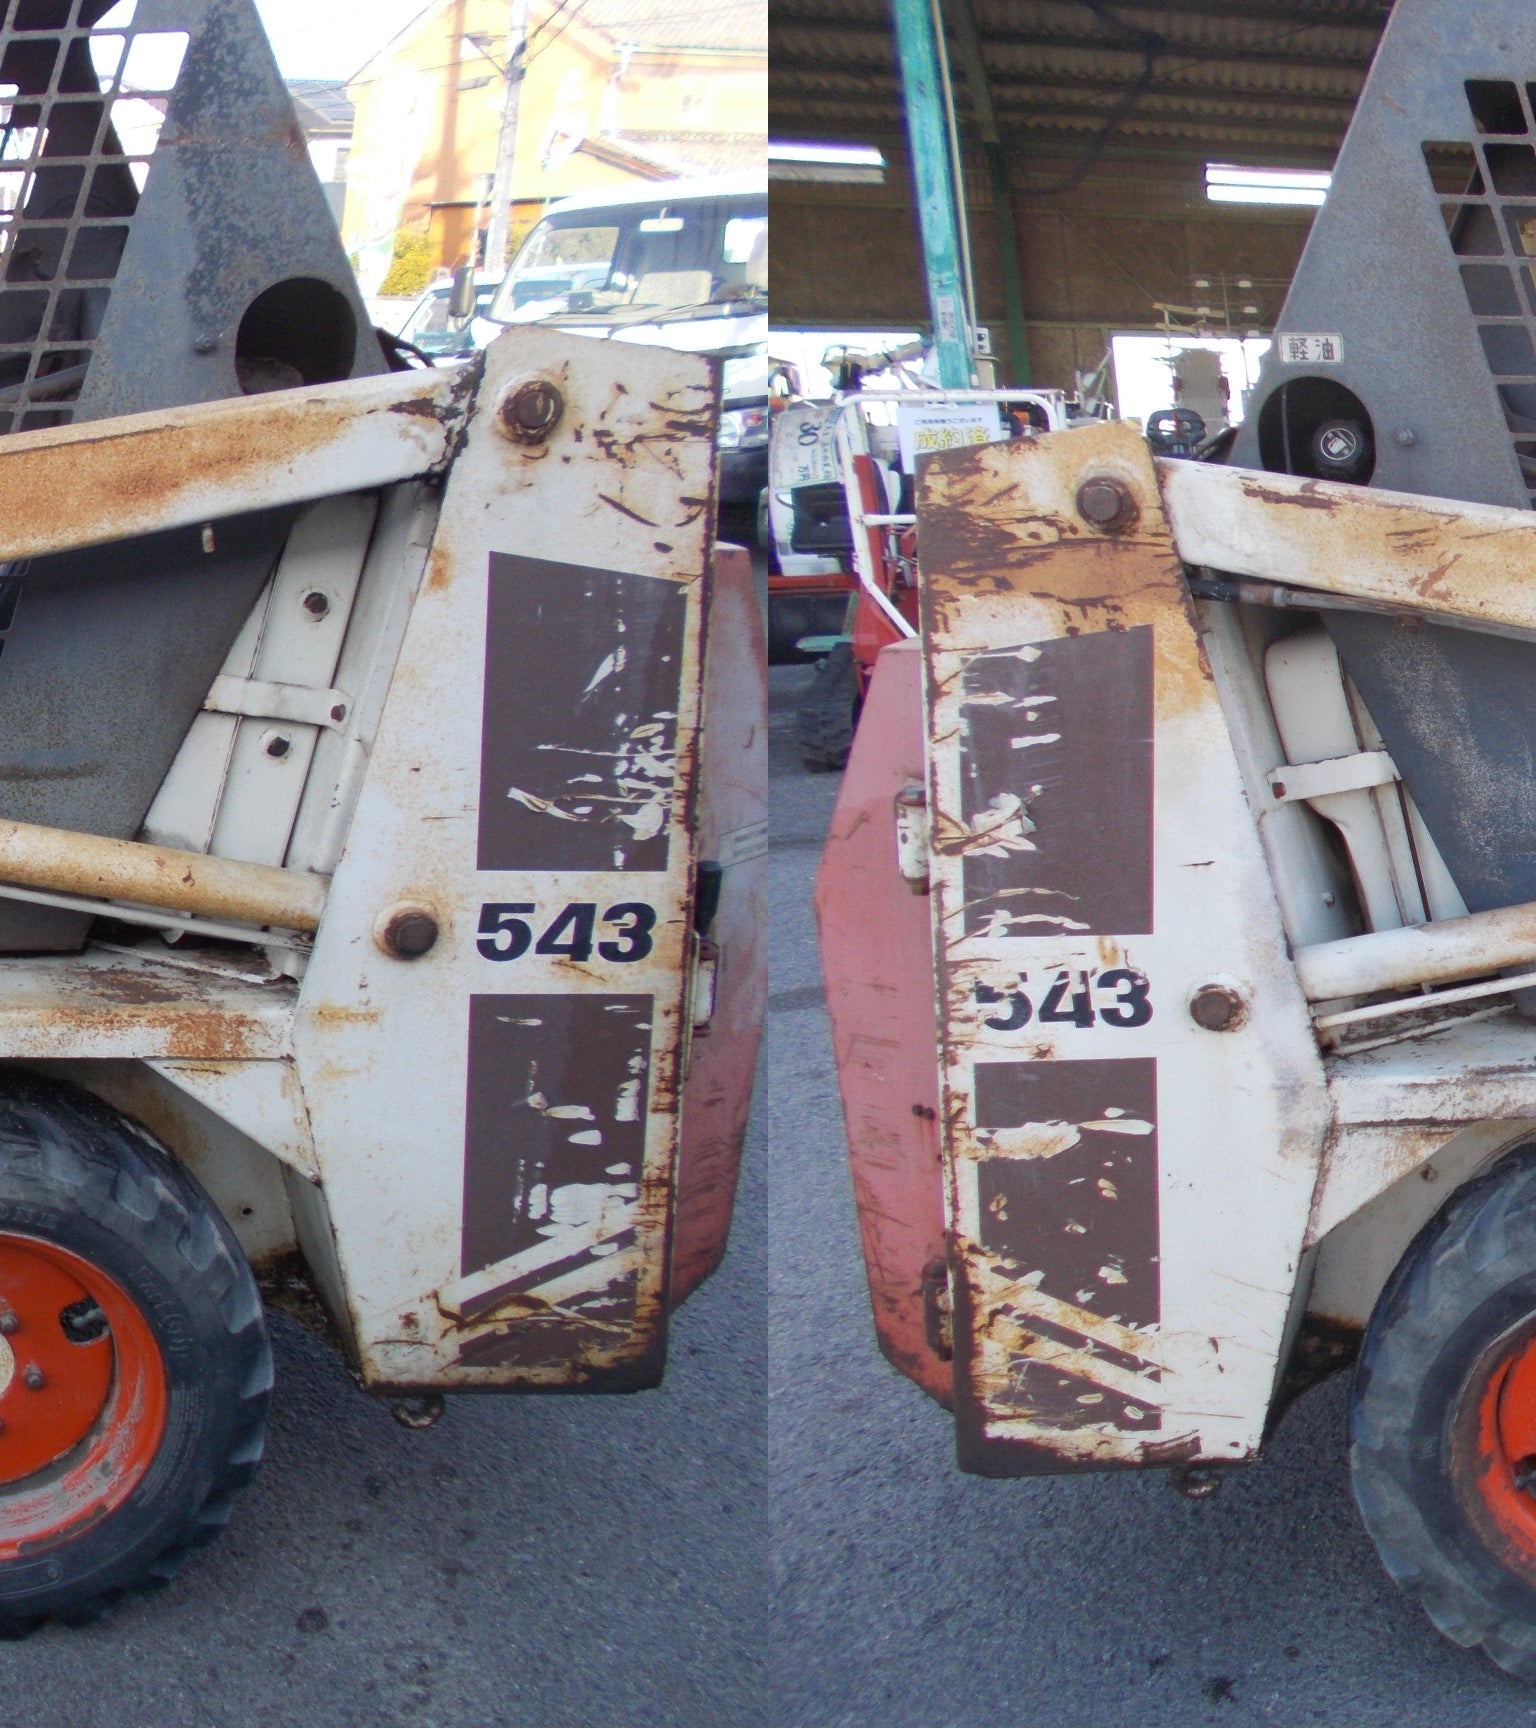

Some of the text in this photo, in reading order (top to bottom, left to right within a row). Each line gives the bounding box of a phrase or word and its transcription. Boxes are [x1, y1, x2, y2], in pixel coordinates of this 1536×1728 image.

[1288, 337, 1334, 360] 軽油
[798, 421, 822, 447] 30
[914, 426, 991, 450] 成約済
[476, 902, 657, 963] 543
[974, 968, 1154, 1031] 543
